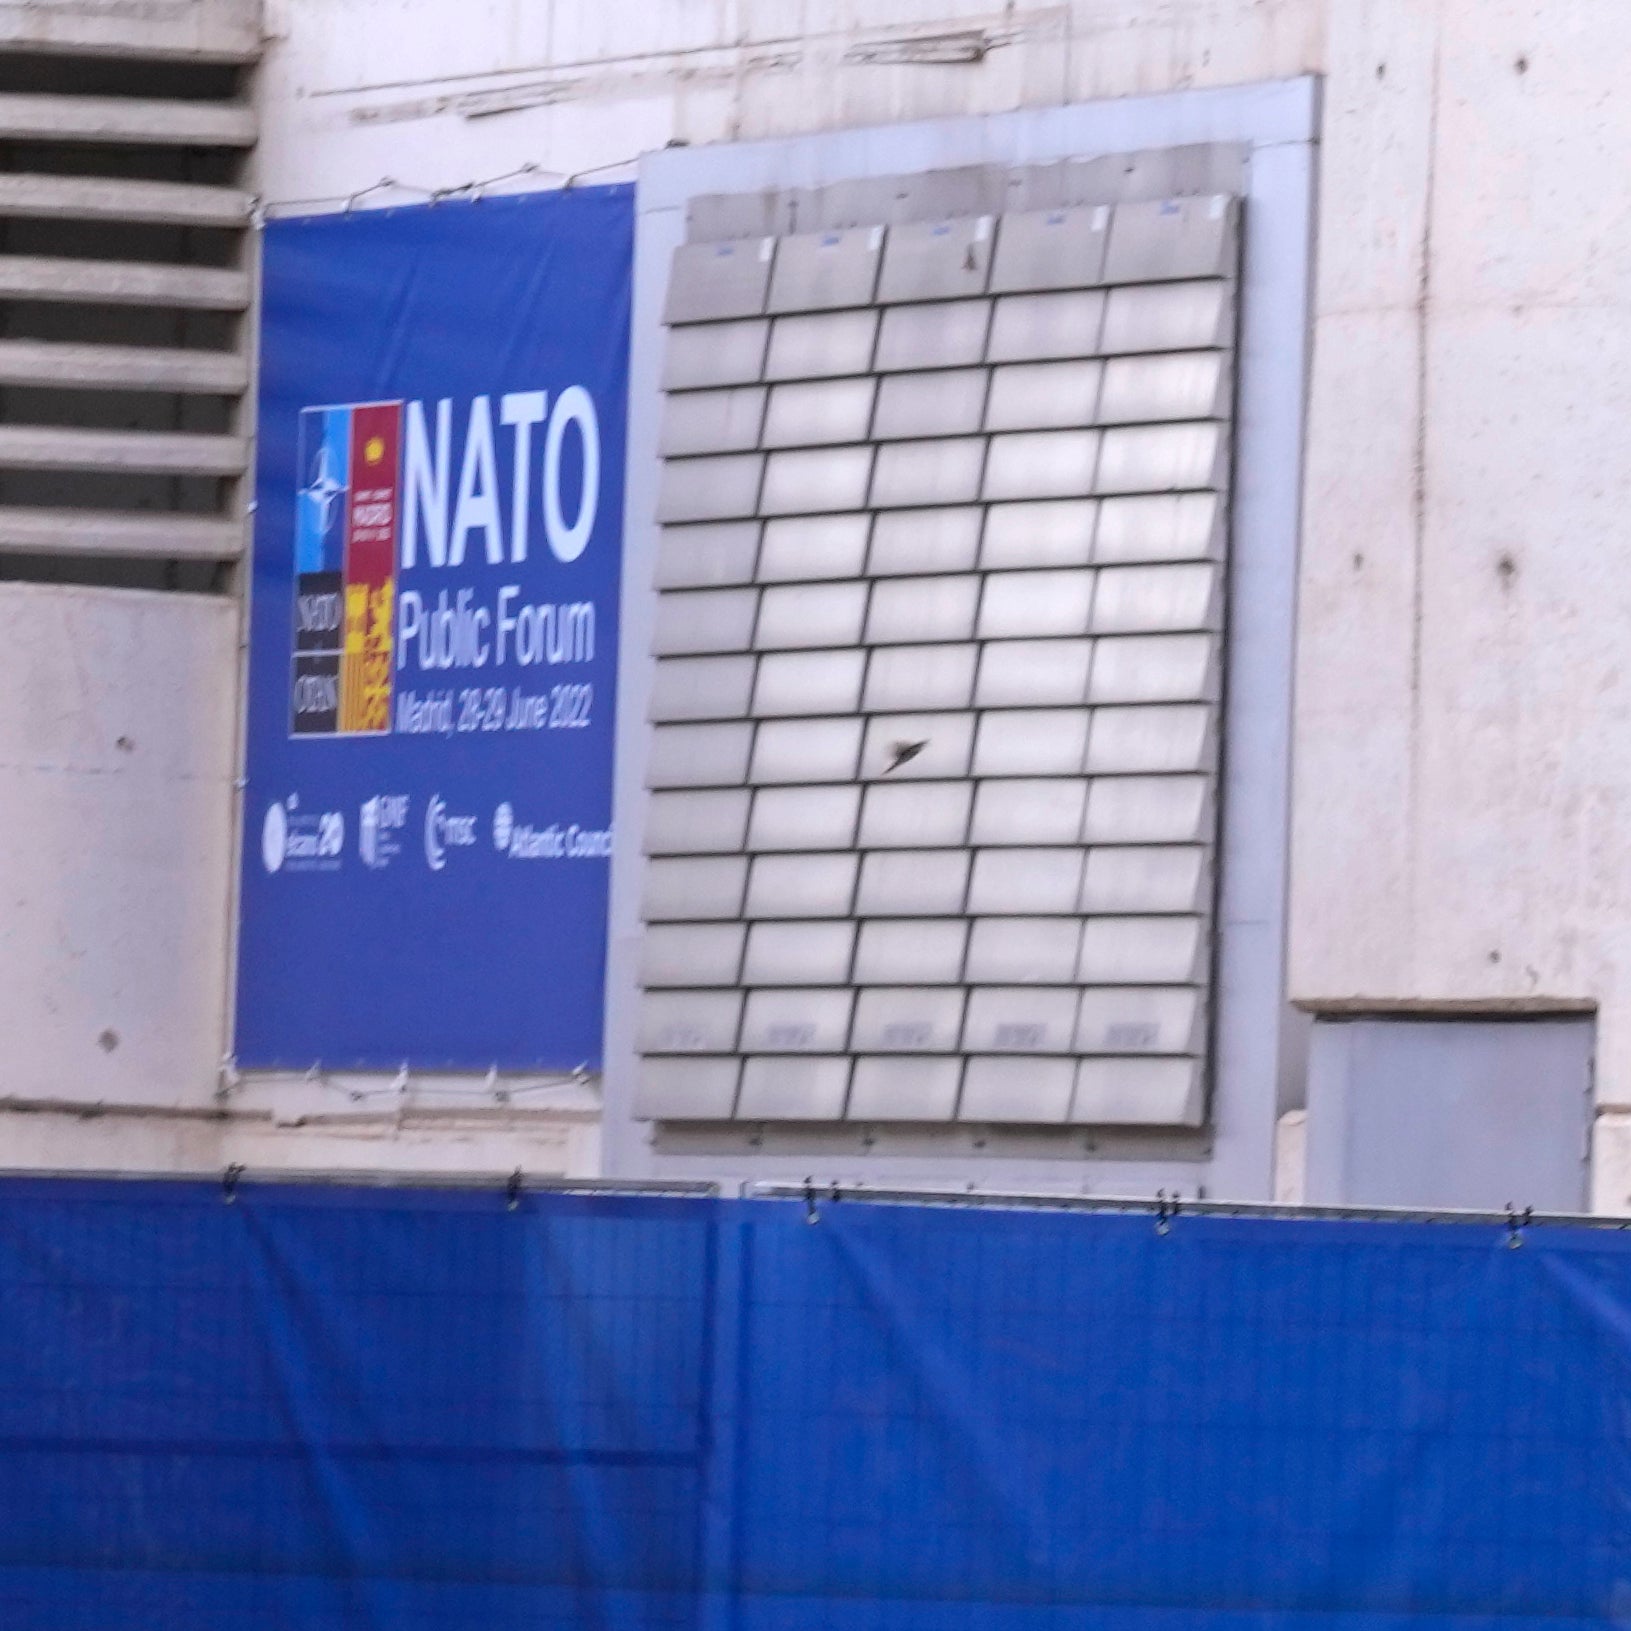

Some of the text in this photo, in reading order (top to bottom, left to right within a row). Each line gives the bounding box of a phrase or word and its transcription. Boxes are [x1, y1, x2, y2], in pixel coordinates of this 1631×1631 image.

[402, 385, 600, 569] NATO
[396, 585, 596, 671] Public Forum
[396, 688, 455, 739] Madrid,
[504, 685, 548, 732] June
[547, 682, 595, 729] 2022
